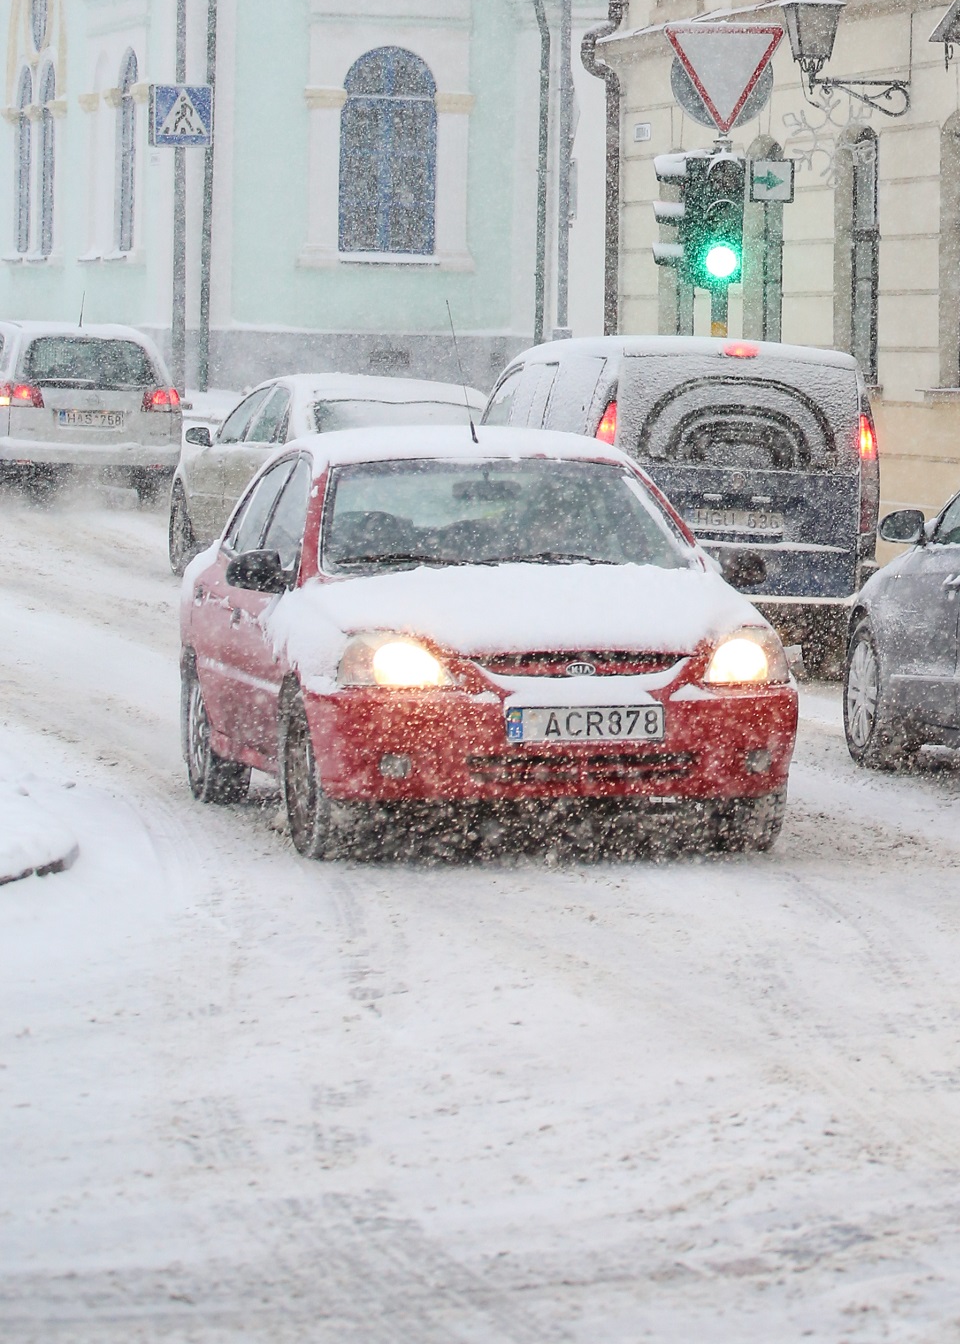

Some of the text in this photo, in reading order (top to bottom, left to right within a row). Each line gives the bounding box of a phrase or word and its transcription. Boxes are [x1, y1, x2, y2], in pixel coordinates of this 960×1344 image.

[100, 414, 121, 426] 758
[570, 665, 592, 674] KIA
[544, 709, 658, 736] ACR878
